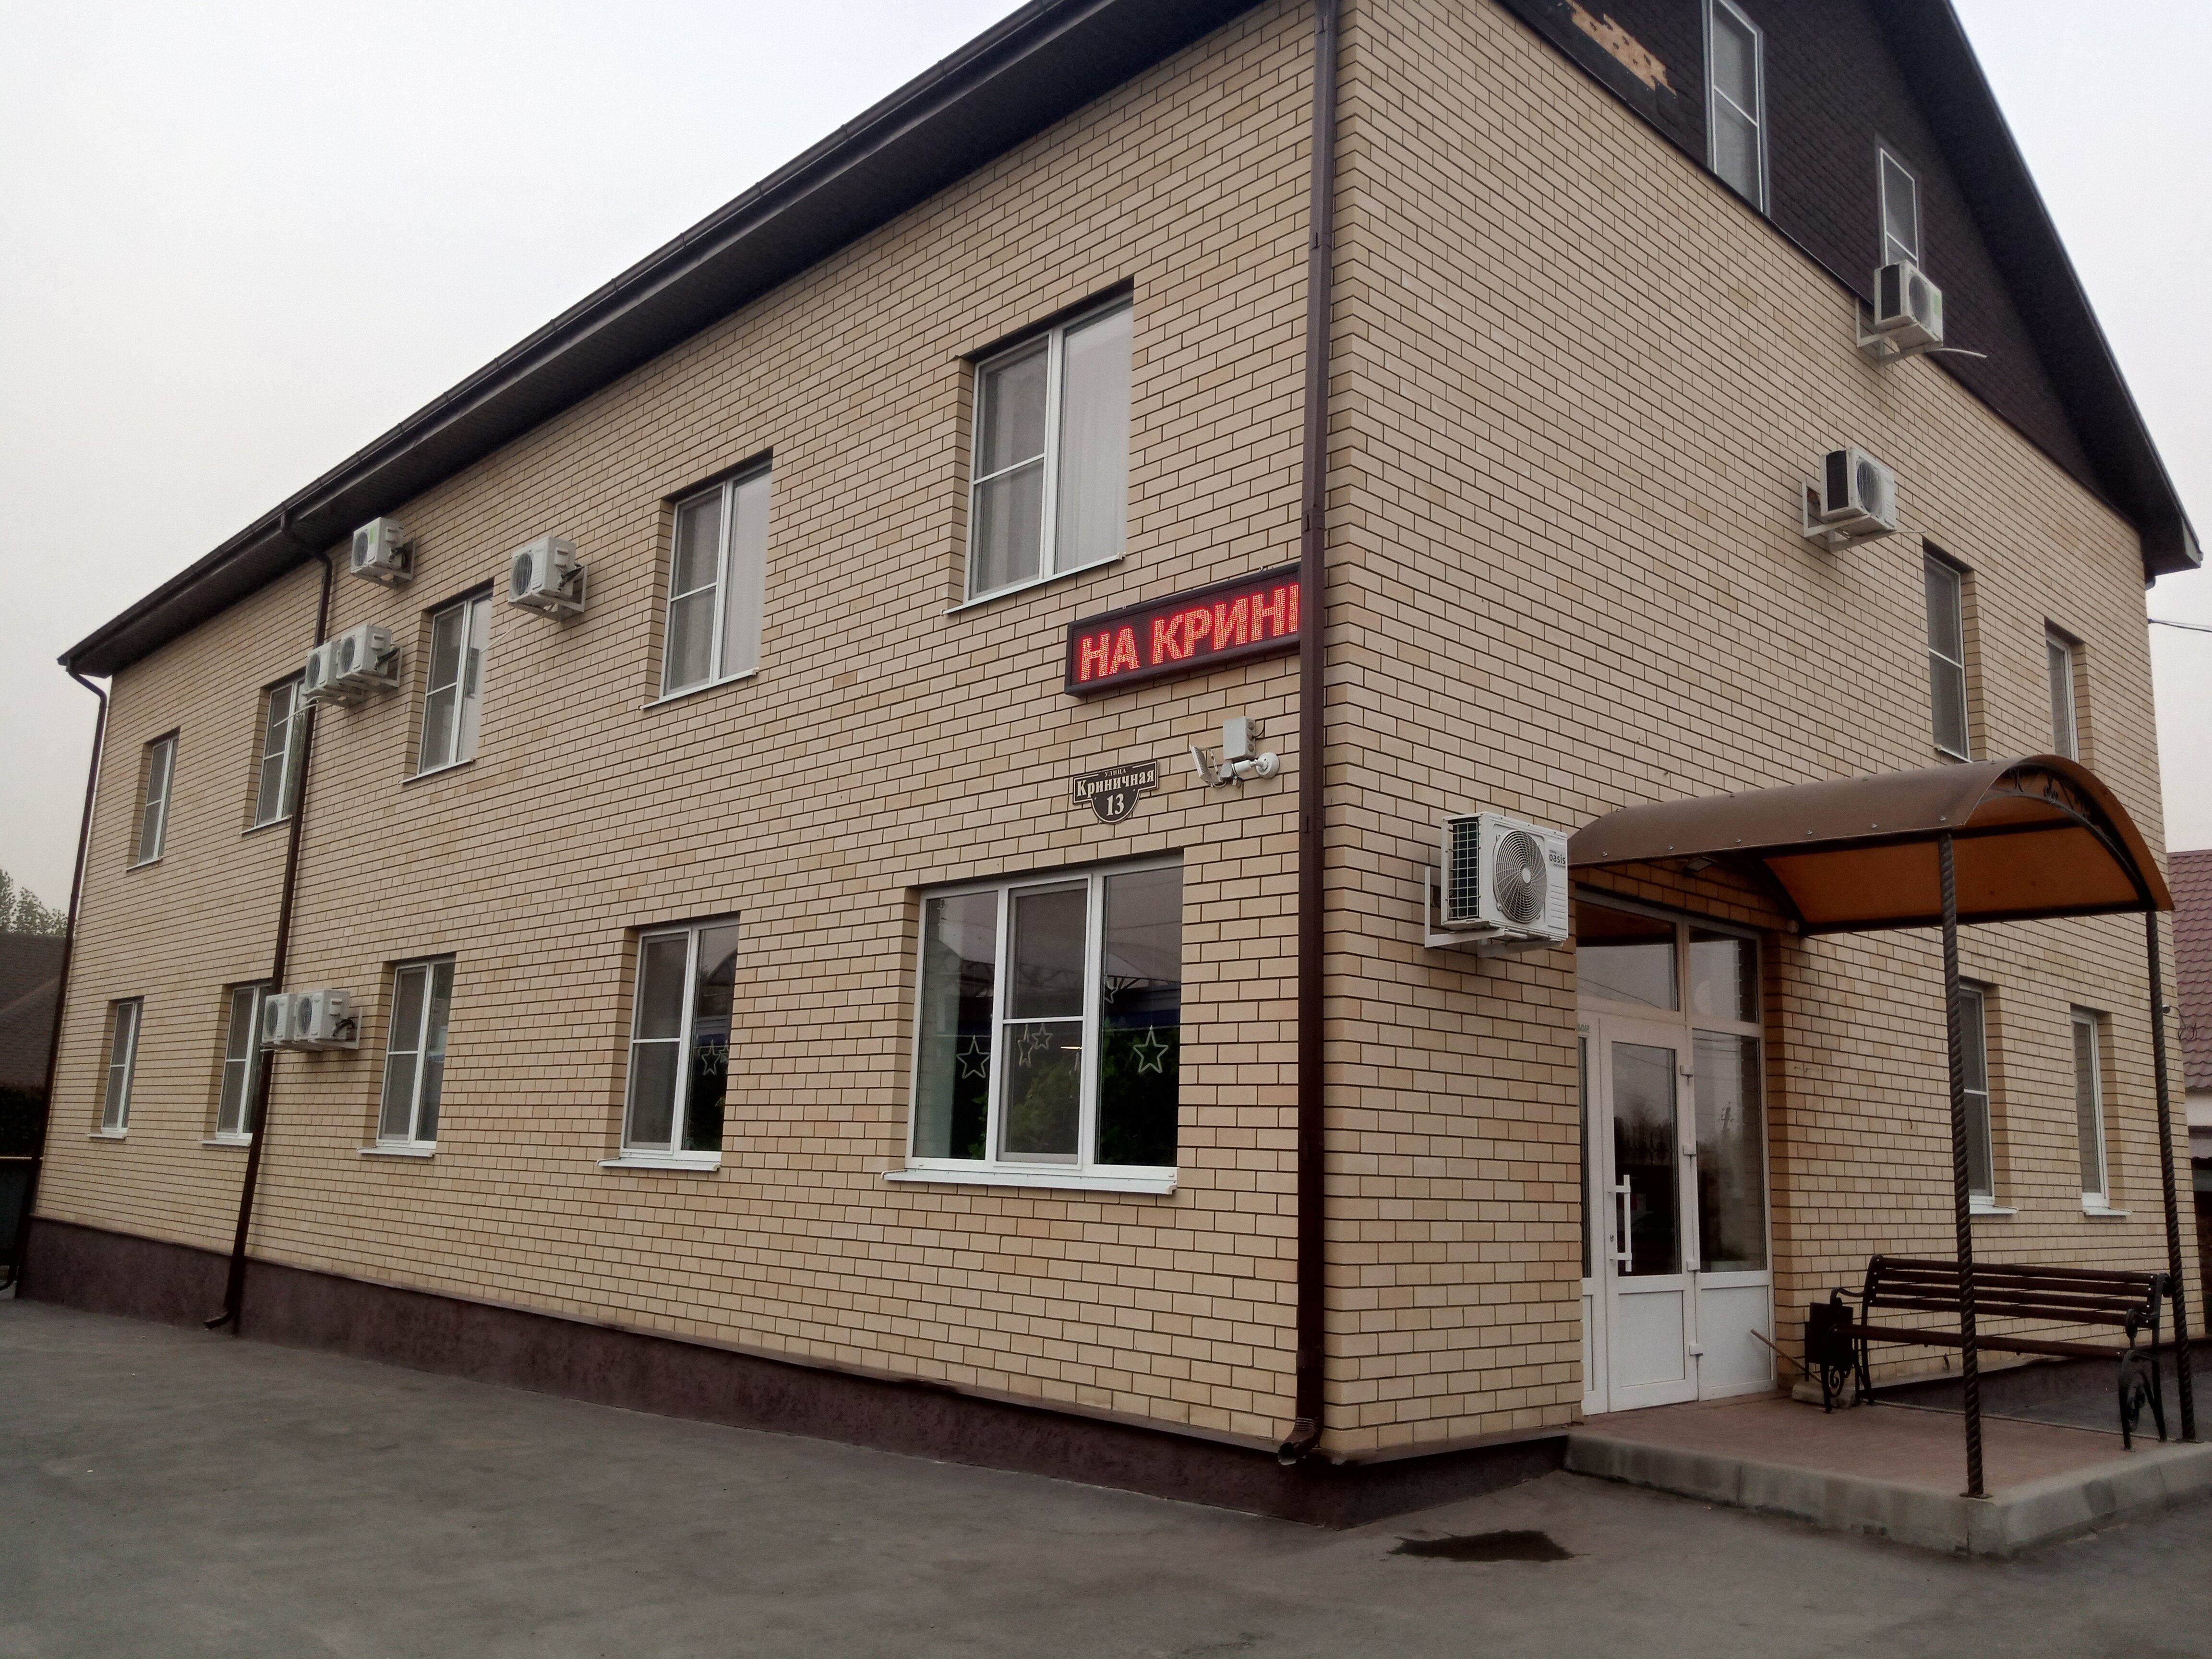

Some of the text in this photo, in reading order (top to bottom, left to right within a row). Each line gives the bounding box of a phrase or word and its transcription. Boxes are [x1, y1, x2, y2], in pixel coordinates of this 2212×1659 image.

[1080, 627, 1140, 681] НА
[1077, 769, 1154, 798] Криничная
[1106, 793, 1125, 816] 13
[1549, 854, 1566, 865] oasis
